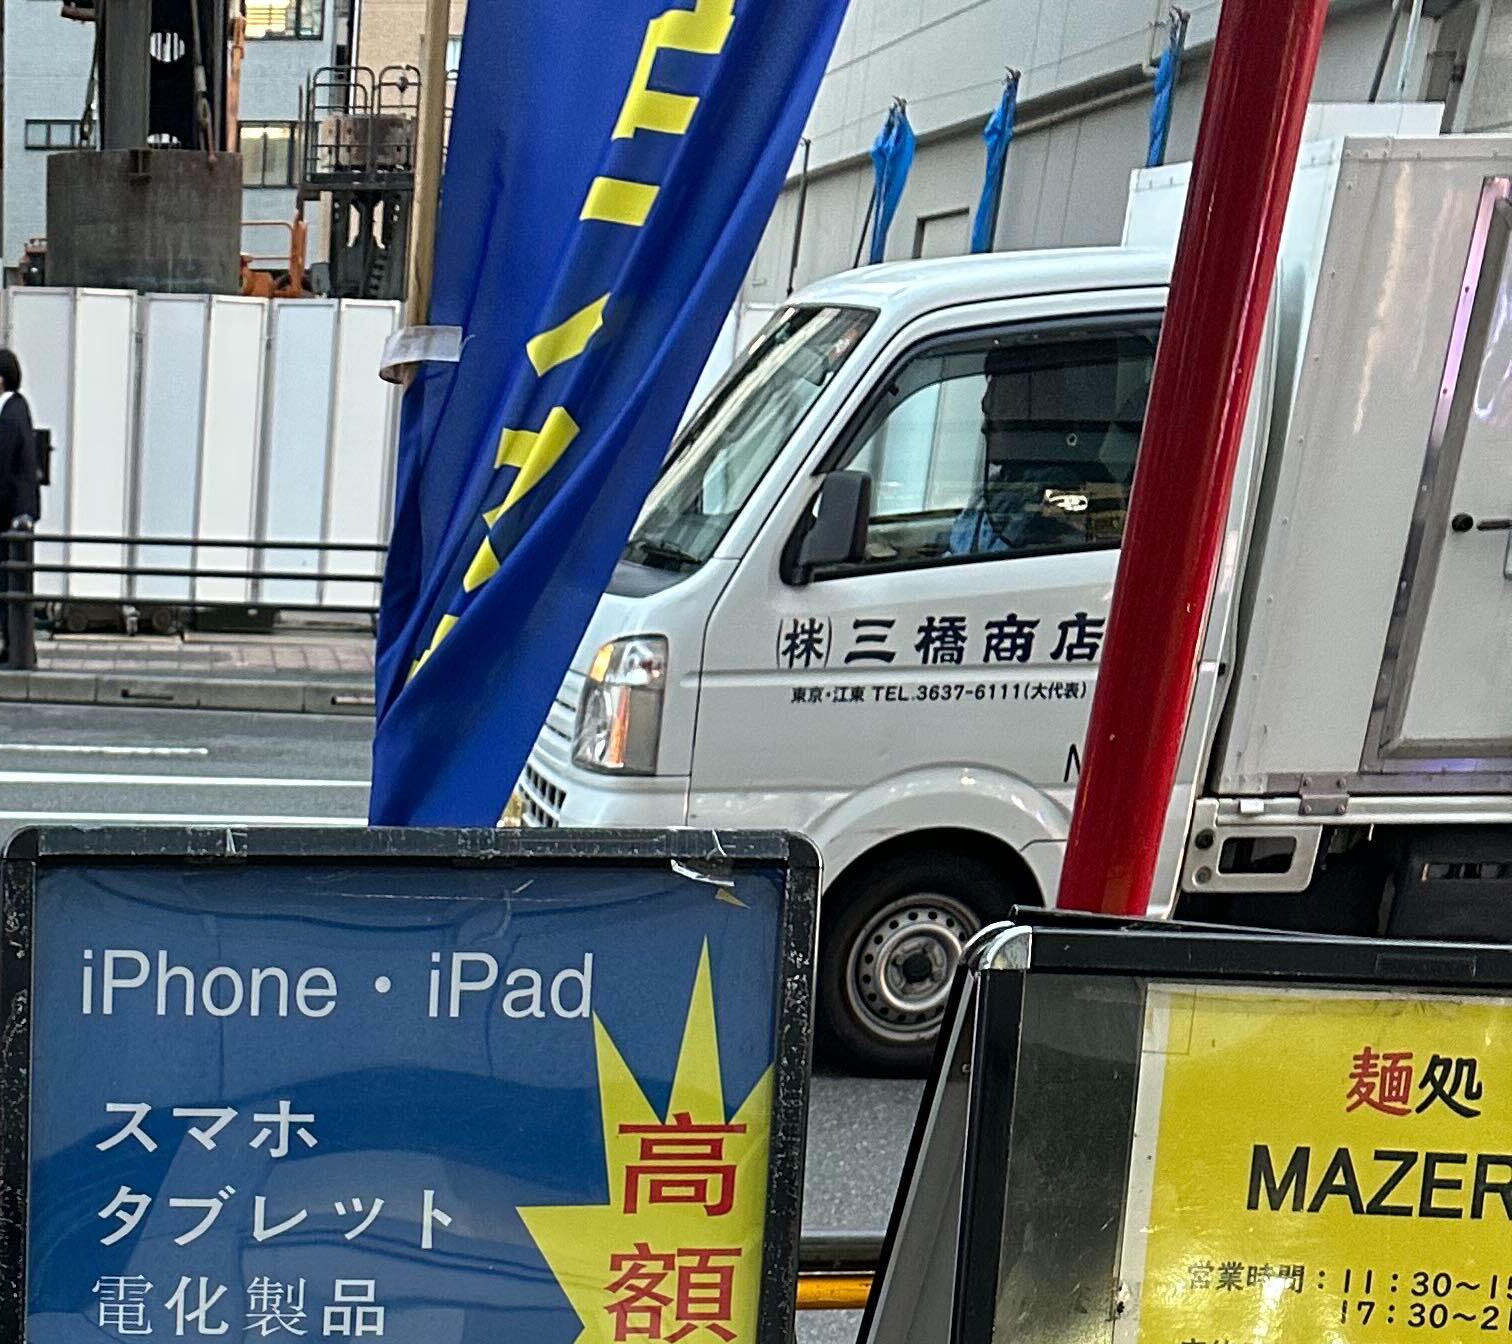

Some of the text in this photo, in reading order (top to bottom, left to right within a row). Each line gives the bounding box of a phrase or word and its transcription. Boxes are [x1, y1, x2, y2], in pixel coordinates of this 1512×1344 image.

[80, 949, 594, 1019] iPhone iPad
[1345, 1045, 1483, 1118] 麺処
[94, 1100, 319, 1159] スマホ
[96, 1184, 453, 1250] タブレット
[91, 1276, 386, 1337] 電化製品
